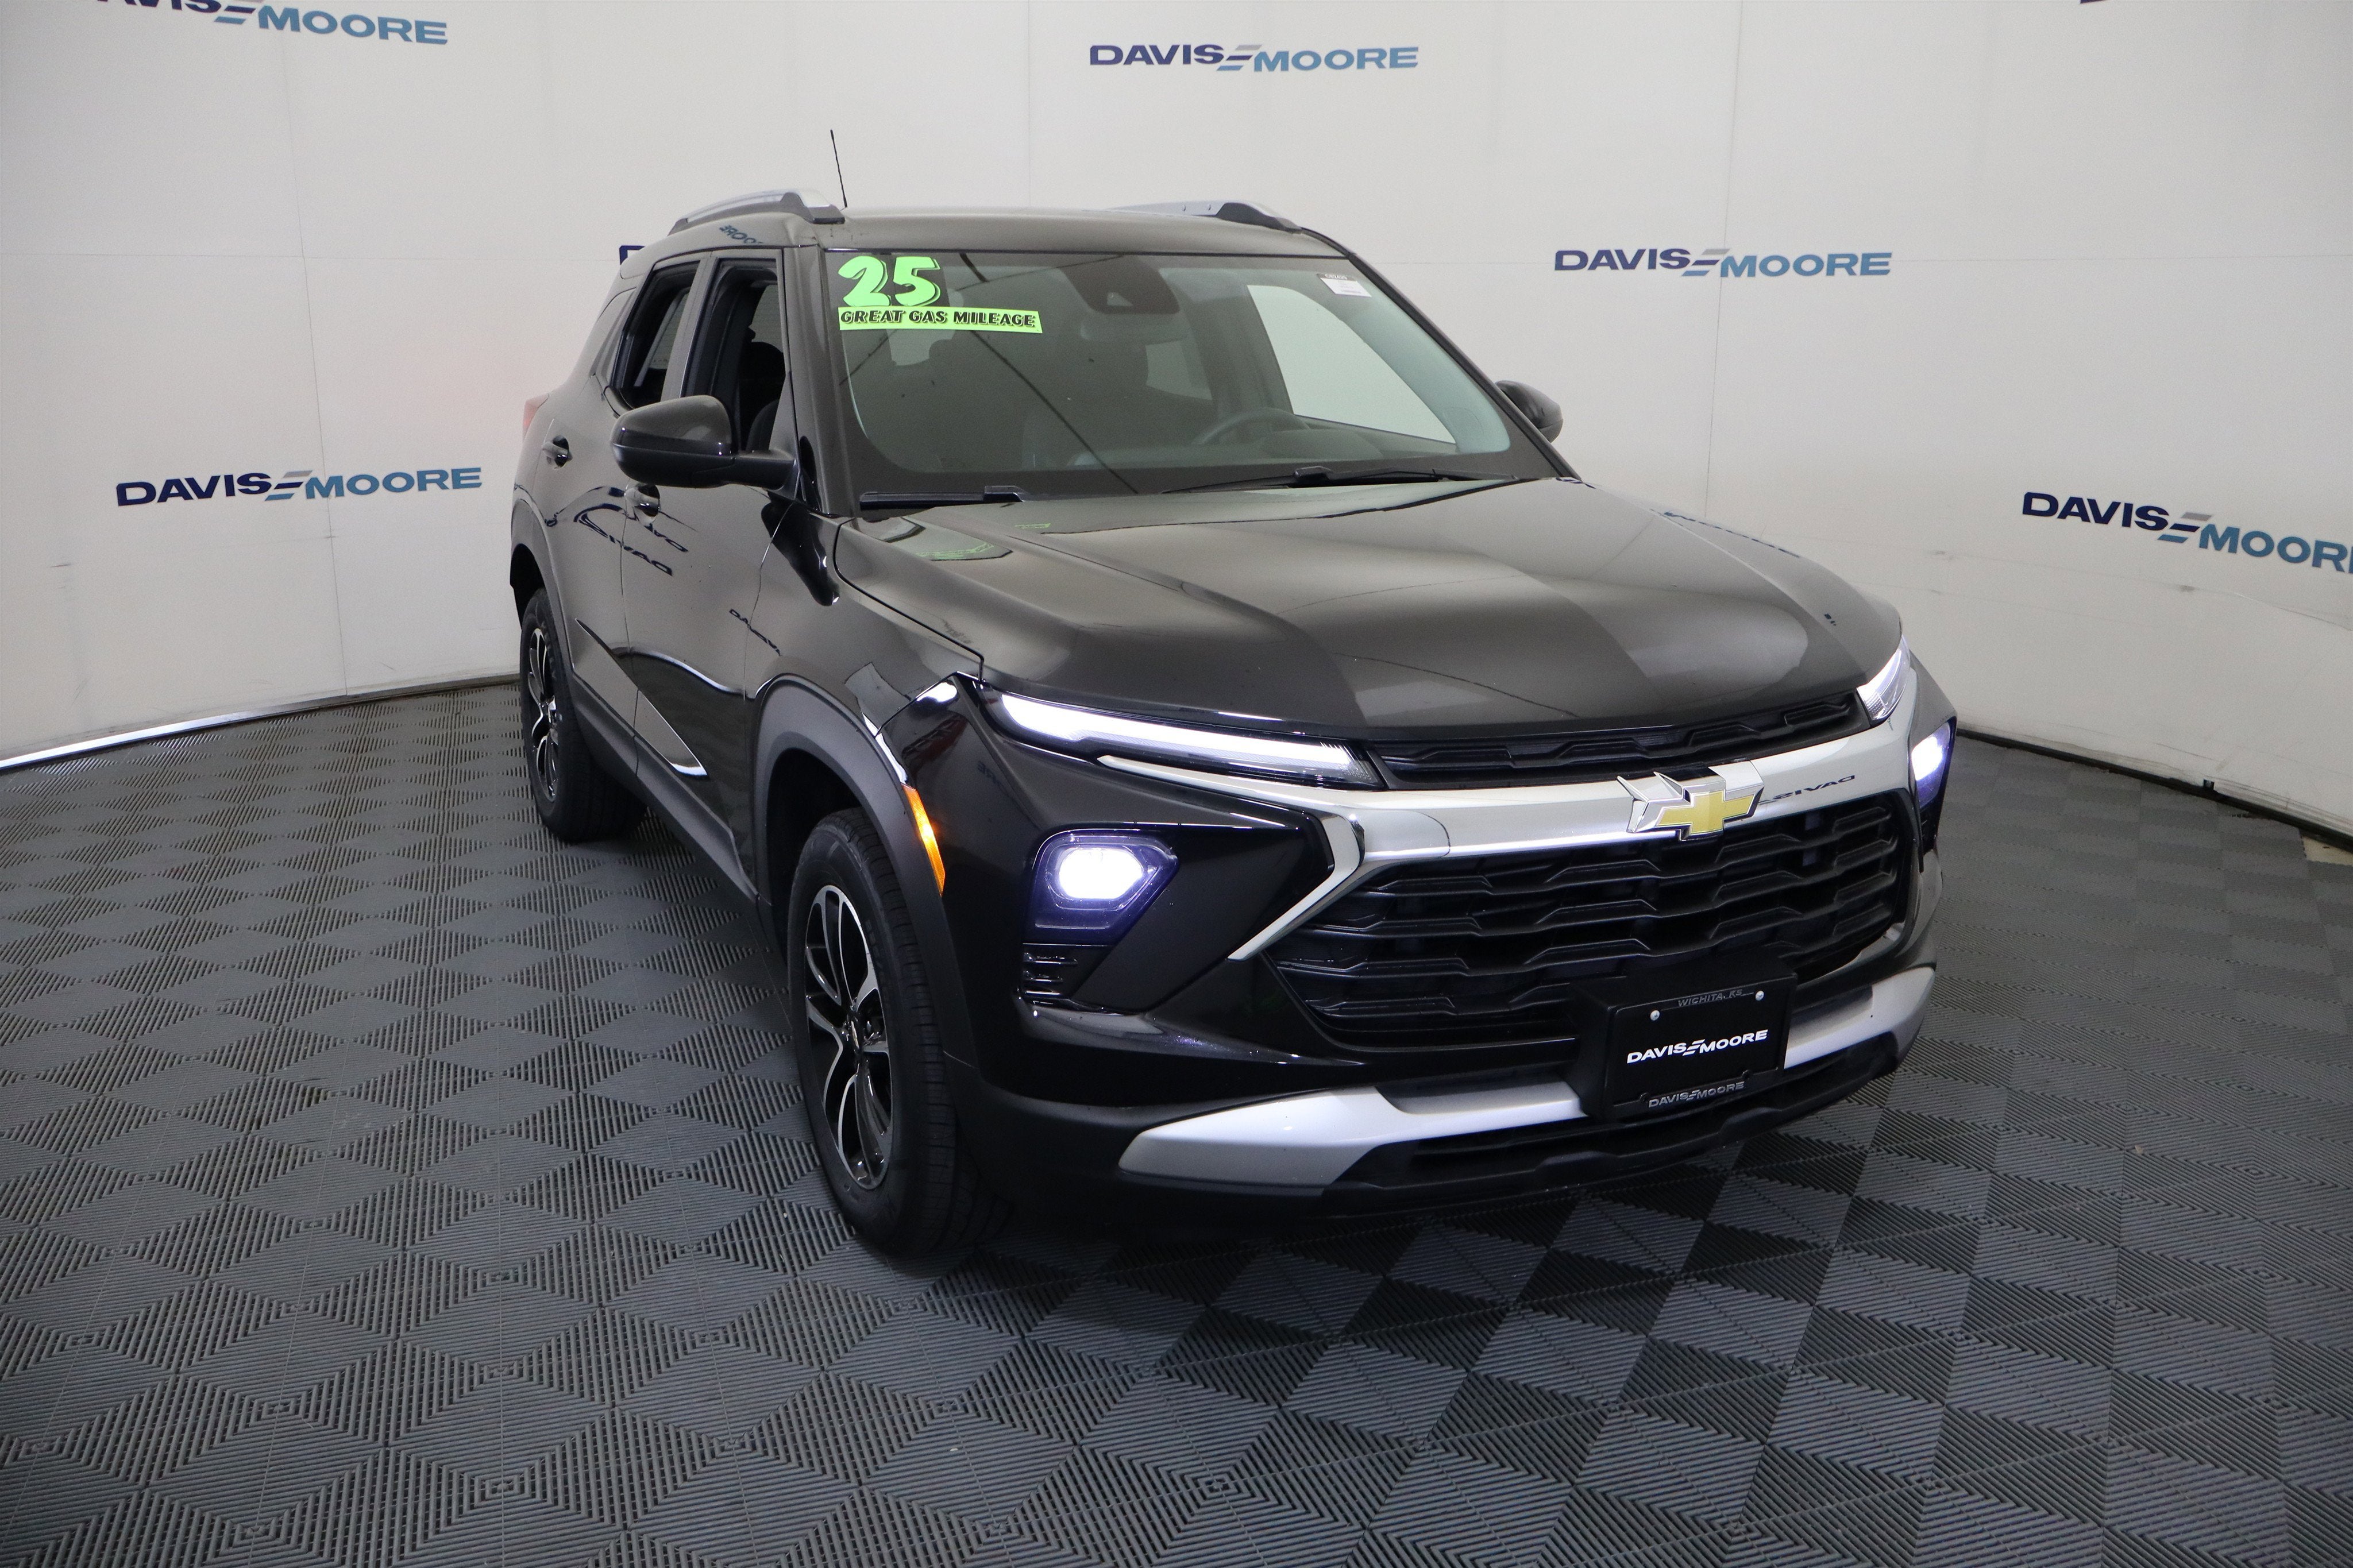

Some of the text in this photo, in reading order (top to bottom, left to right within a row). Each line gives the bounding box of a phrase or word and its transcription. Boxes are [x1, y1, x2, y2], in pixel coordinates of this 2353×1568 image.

[258, 5, 448, 45] MOORE
[1090, 44, 1419, 72] DAVIS MOORE
[1554, 248, 1892, 277] DAVIS MOORE
[838, 256, 941, 307] 25
[840, 310, 1036, 327] GREAT GAS MILEAGE
[115, 467, 483, 507] DAVIS MOORE
[2022, 492, 2353, 574] DAVIS MOOR
[1627, 1029, 1768, 1064] DAVIS MOORE
[1648, 1081, 1745, 1109] DAVIS MOORE
